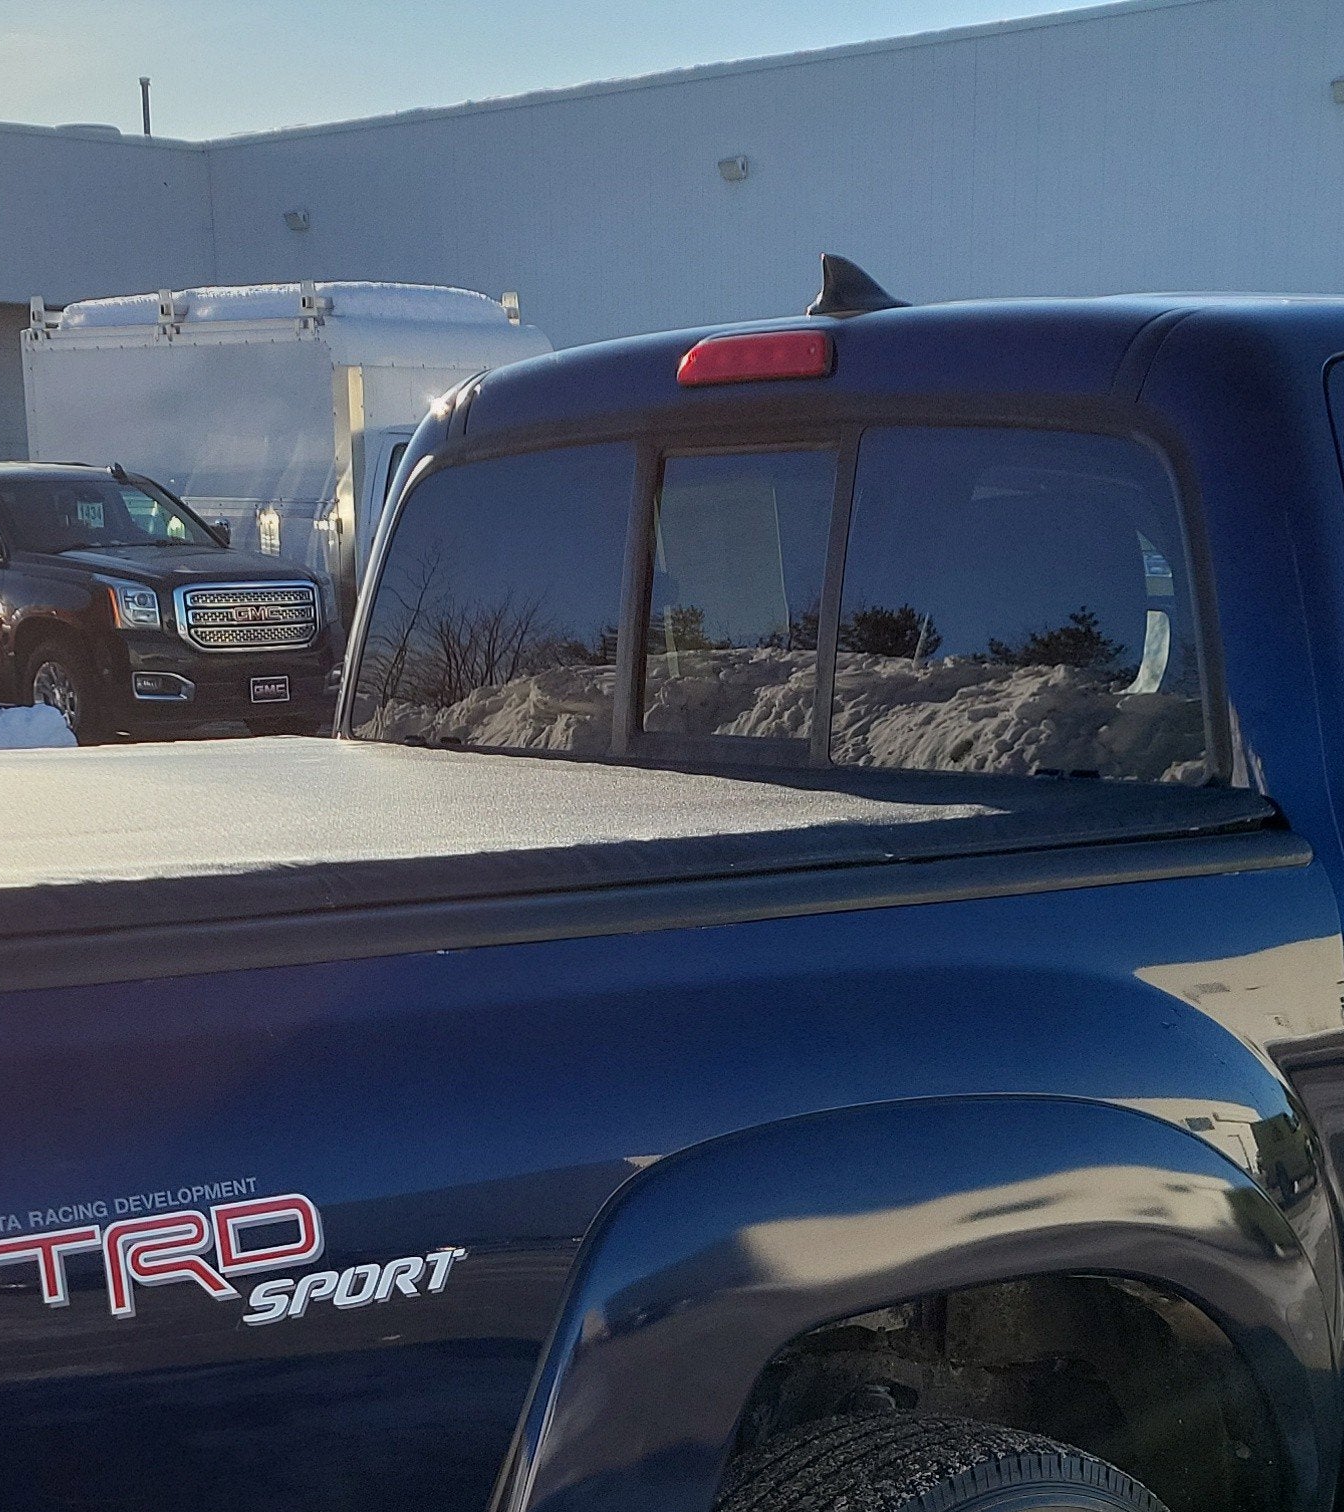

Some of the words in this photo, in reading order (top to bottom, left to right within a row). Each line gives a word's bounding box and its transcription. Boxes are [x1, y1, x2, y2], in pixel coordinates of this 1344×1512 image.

[233, 606, 282, 622] GMC
[254, 684, 285, 695] GMC
[28, 1202, 108, 1227] RACING
[114, 1177, 258, 1214] DEVELOPMENT
[243, 1247, 469, 1327] SPORT
